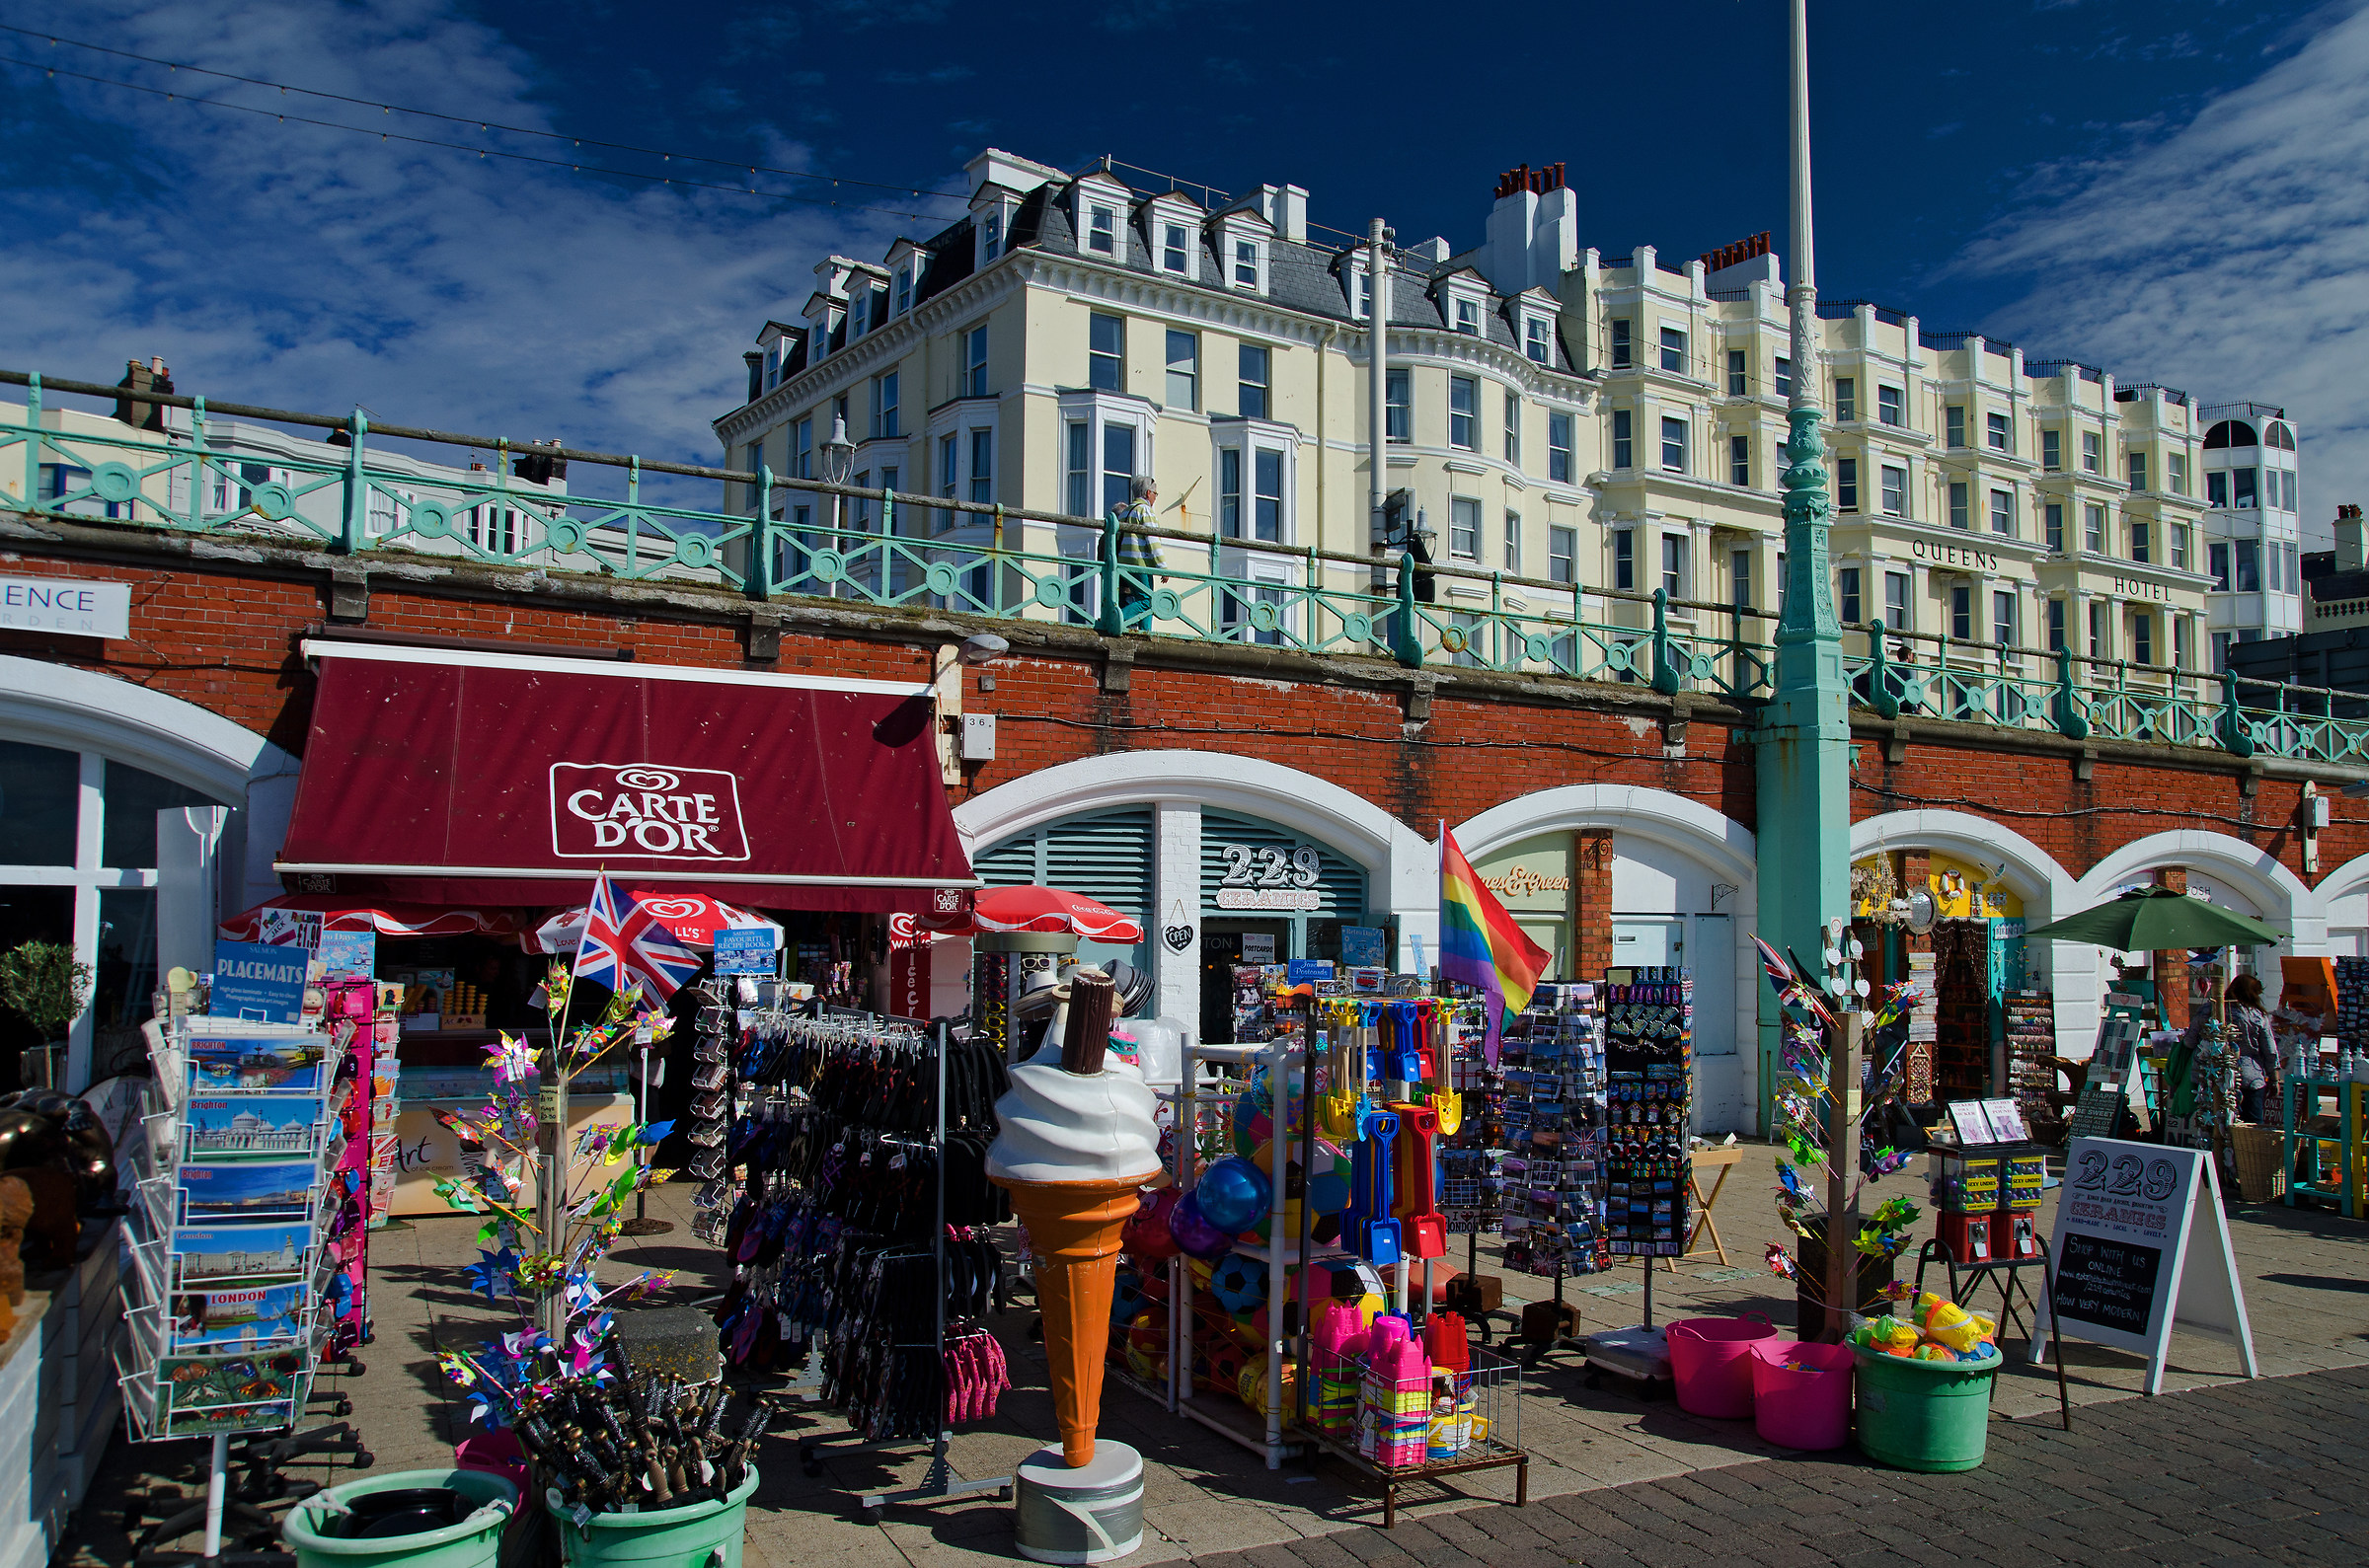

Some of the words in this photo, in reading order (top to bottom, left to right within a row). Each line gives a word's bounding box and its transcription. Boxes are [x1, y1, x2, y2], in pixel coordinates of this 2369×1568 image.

[1912, 539, 1998, 570] QUEENS
[2114, 576, 2172, 601] HOTEL
[0, 584, 95, 612] ENCE
[568, 788, 721, 824] CARTE
[1221, 844, 1322, 887] 229
[303, 878, 331, 887] CARTE
[937, 894, 959, 903] CARTE
[1218, 890, 1320, 909] CERAMICS
[297, 924, 321, 948] £1.99
[1169, 929, 1191, 942] OPEN
[1244, 944, 1274, 953] POSTCARDS
[217, 959, 304, 984] PLACEMATS
[1294, 966, 1328, 977] Postcards
[191, 1041, 226, 1050] BRIGHTON
[2093, 1091, 2118, 1100] HAPPY
[191, 1100, 228, 1111] Brighton
[395, 1136, 431, 1173] Art
[181, 1168, 213, 1181] Brighton
[2073, 1150, 2178, 1201] 229
[2070, 1201, 2167, 1230] CERAMICS
[177, 1232, 214, 1240] London
[2144, 1230, 2162, 1238] LOVELY
[2088, 1260, 2124, 1277] ONLINE
[211, 1291, 267, 1305] LONDON
[2057, 1293, 2075, 1307] HOW
[2079, 1299, 2100, 1313] VERY
